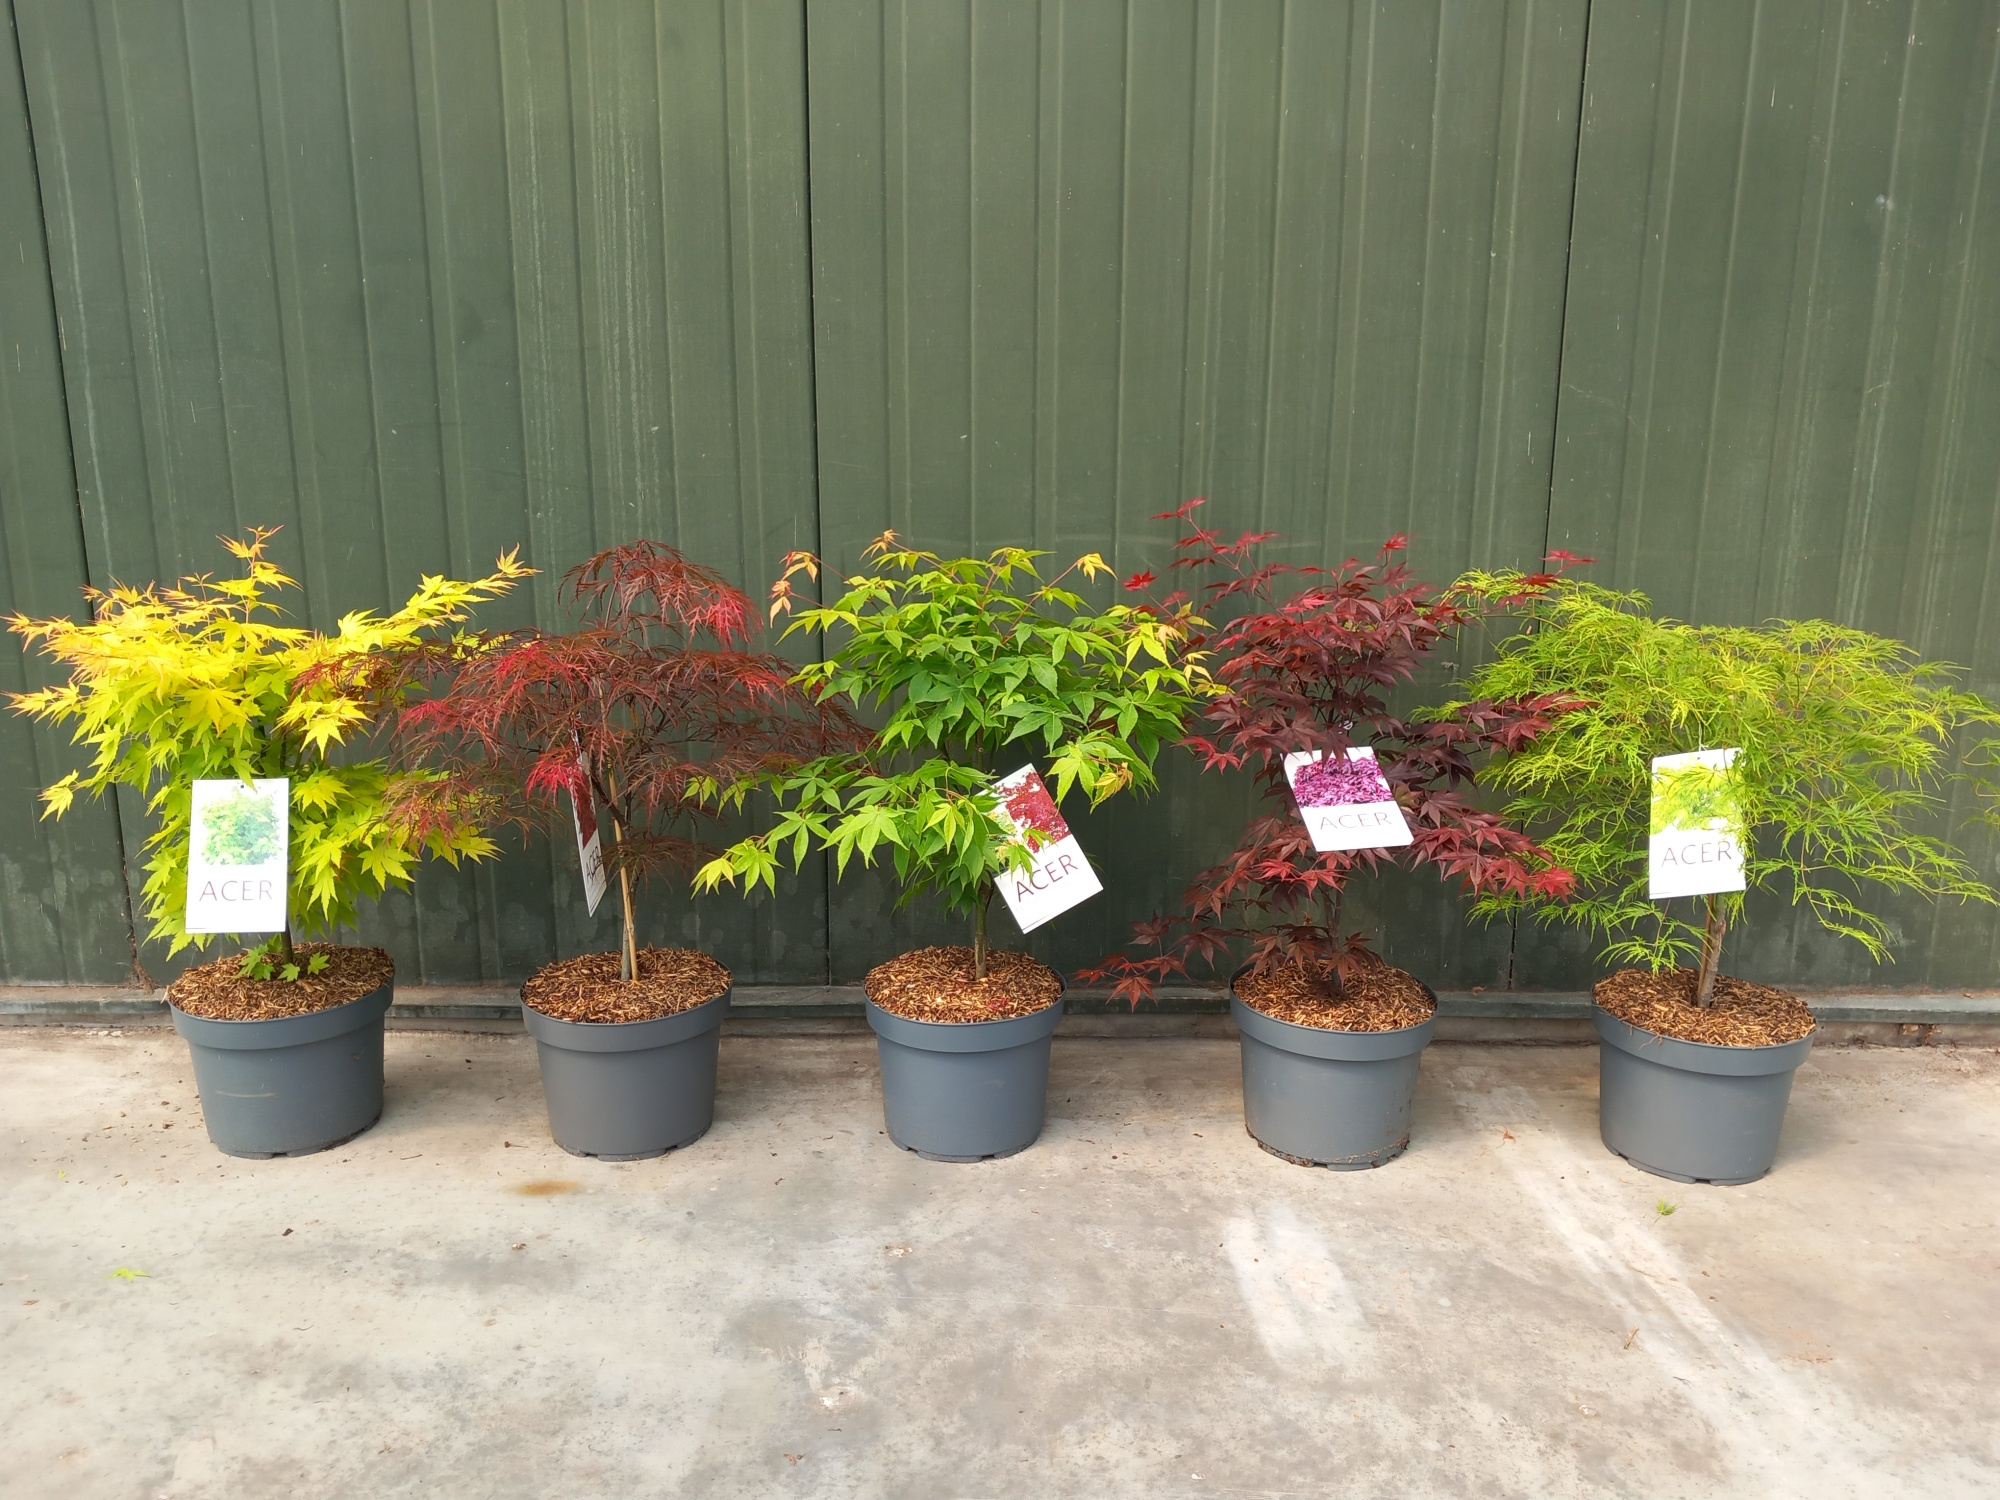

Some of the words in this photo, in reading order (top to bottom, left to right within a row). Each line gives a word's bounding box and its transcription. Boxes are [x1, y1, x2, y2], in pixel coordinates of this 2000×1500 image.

[1320, 811, 1393, 830] ACER
[1661, 840, 1732, 868] ACER
[198, 880, 273, 902] ACER
[1016, 854, 1079, 903] ACER
